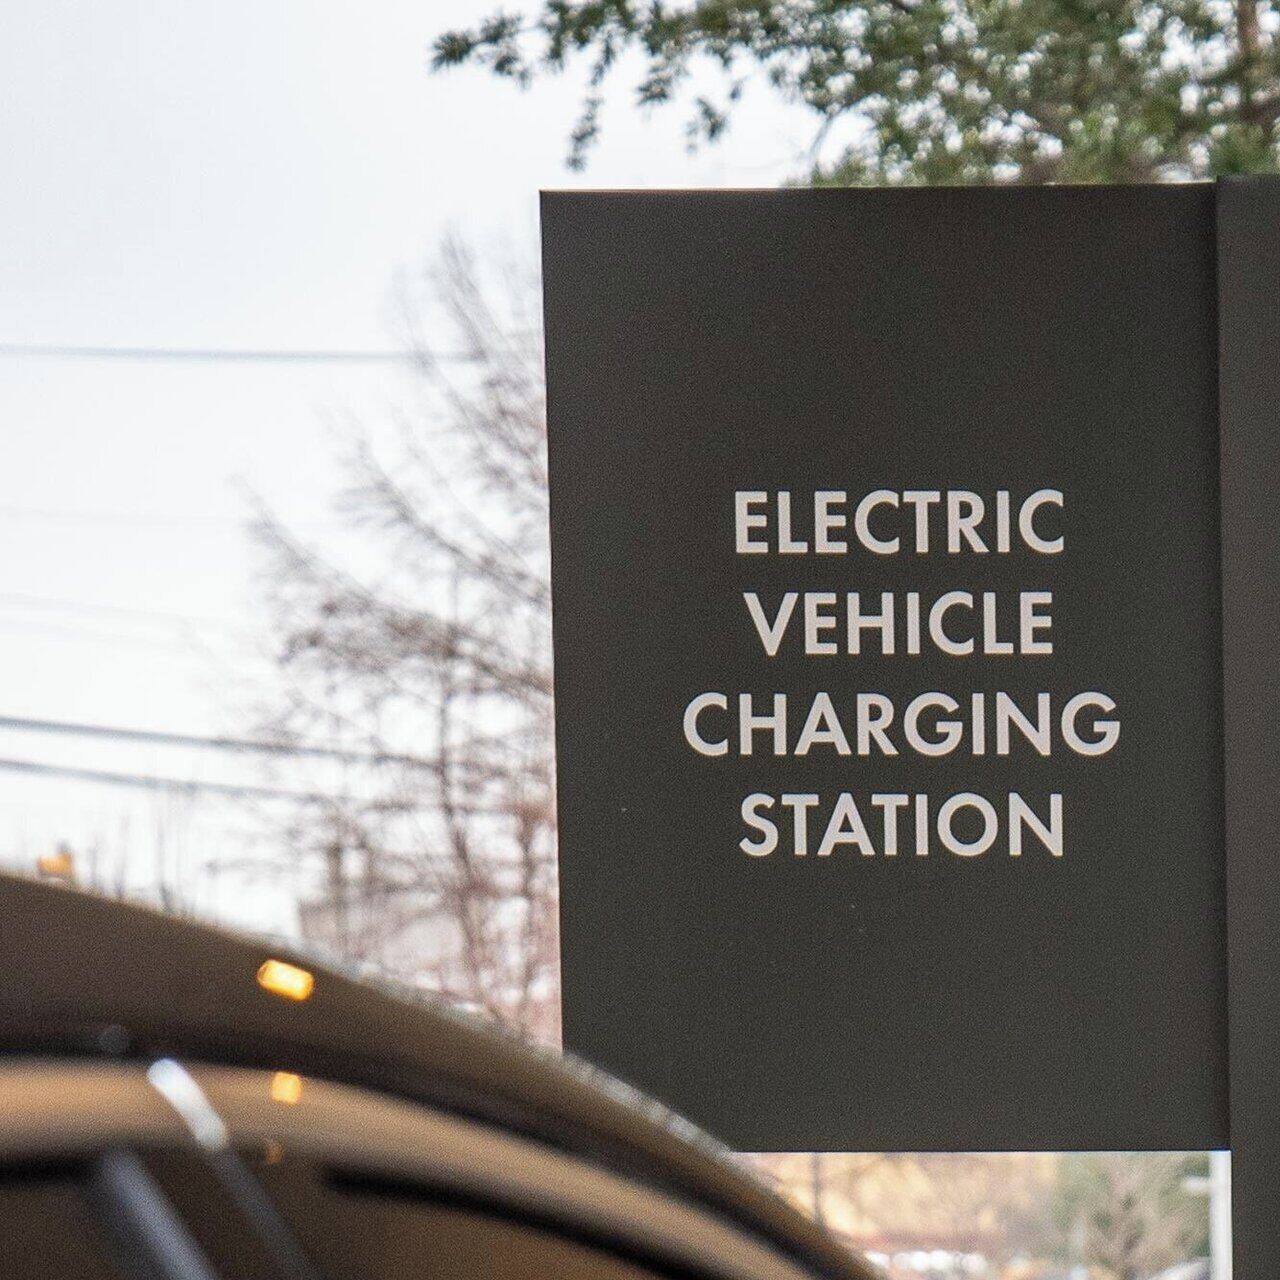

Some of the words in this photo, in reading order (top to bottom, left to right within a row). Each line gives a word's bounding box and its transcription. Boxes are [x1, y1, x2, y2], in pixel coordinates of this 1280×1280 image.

[734, 488, 1065, 555] ELECTRIC
[743, 590, 1054, 657] VEHICLE
[682, 691, 1122, 757] CHARGING
[738, 792, 1064, 857] STATION
